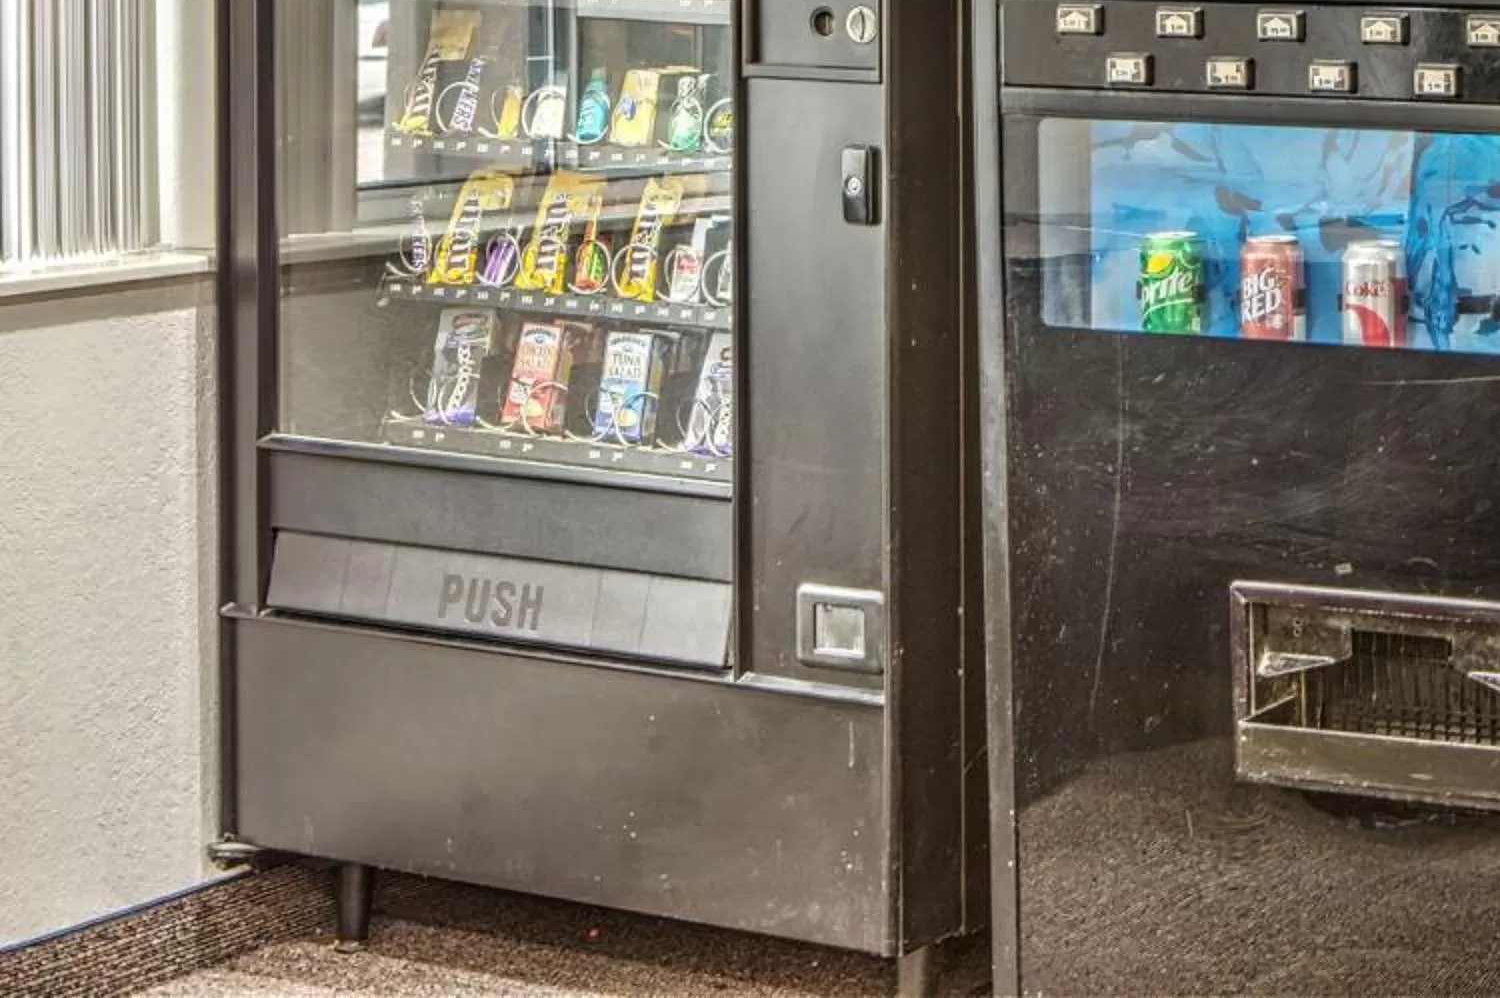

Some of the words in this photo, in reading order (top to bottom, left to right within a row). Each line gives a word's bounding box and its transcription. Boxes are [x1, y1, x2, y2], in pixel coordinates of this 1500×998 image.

[1242, 268, 1276, 293] BIG
[1241, 288, 1281, 322] RED
[437, 573, 546, 631] PUSH
